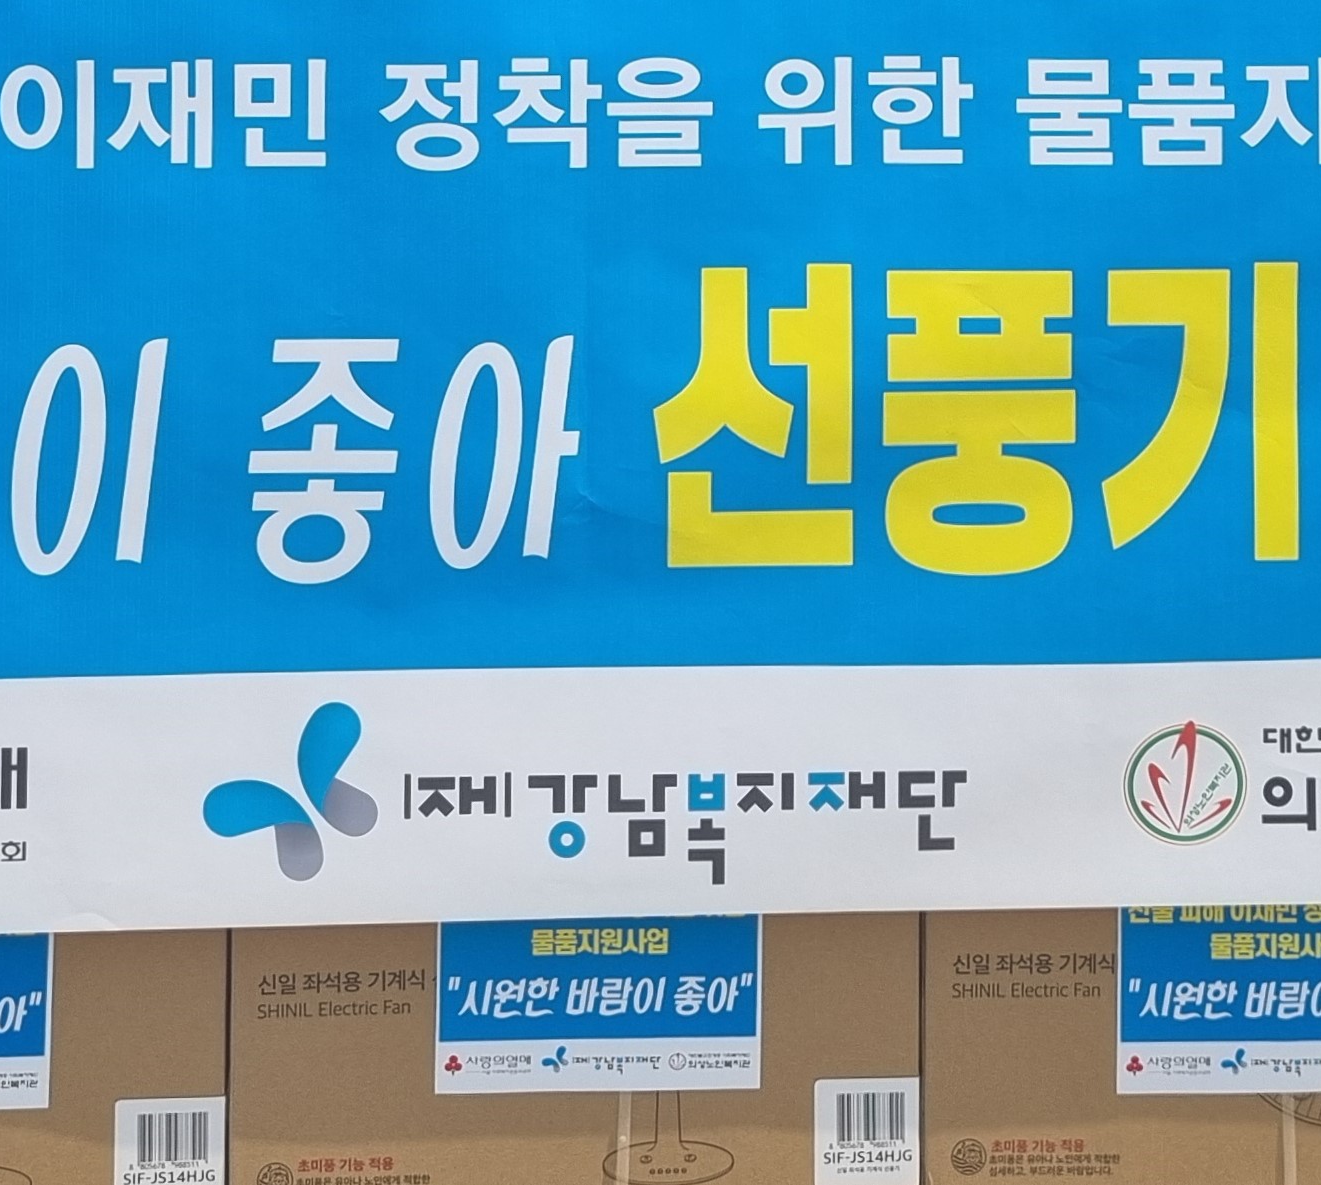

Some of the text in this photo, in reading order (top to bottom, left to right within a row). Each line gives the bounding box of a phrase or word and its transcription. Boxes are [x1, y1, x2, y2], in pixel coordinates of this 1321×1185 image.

[0, 59, 326, 168] 이재민
[380, 58, 713, 171] 정착을
[759, 56, 973, 165] 위한
[249, 335, 580, 583] 좋아
[656, 262, 1299, 574] 선풍기
[531, 928, 669, 956] 물품지원사업
[953, 953, 1115, 975] 신일 좌석용 기계식
[258, 969, 425, 996] 신일 좌석용 기계식
[952, 982, 1101, 999] SHINIL Electric Fan
[448, 972, 754, 1019] "시원한 바람이 좋아"
[1129, 978, 1238, 1020] "시원한
[257, 1000, 411, 1020] SHINIL Electric Fan
[823, 1149, 913, 1164] SIF-JS14HJG
[991, 1138, 1084, 1153] 초미풍 기능 적용
[297, 1156, 394, 1173] 초미풍 기능 적용
[123, 1169, 216, 1185] SIF-JS14HJG
